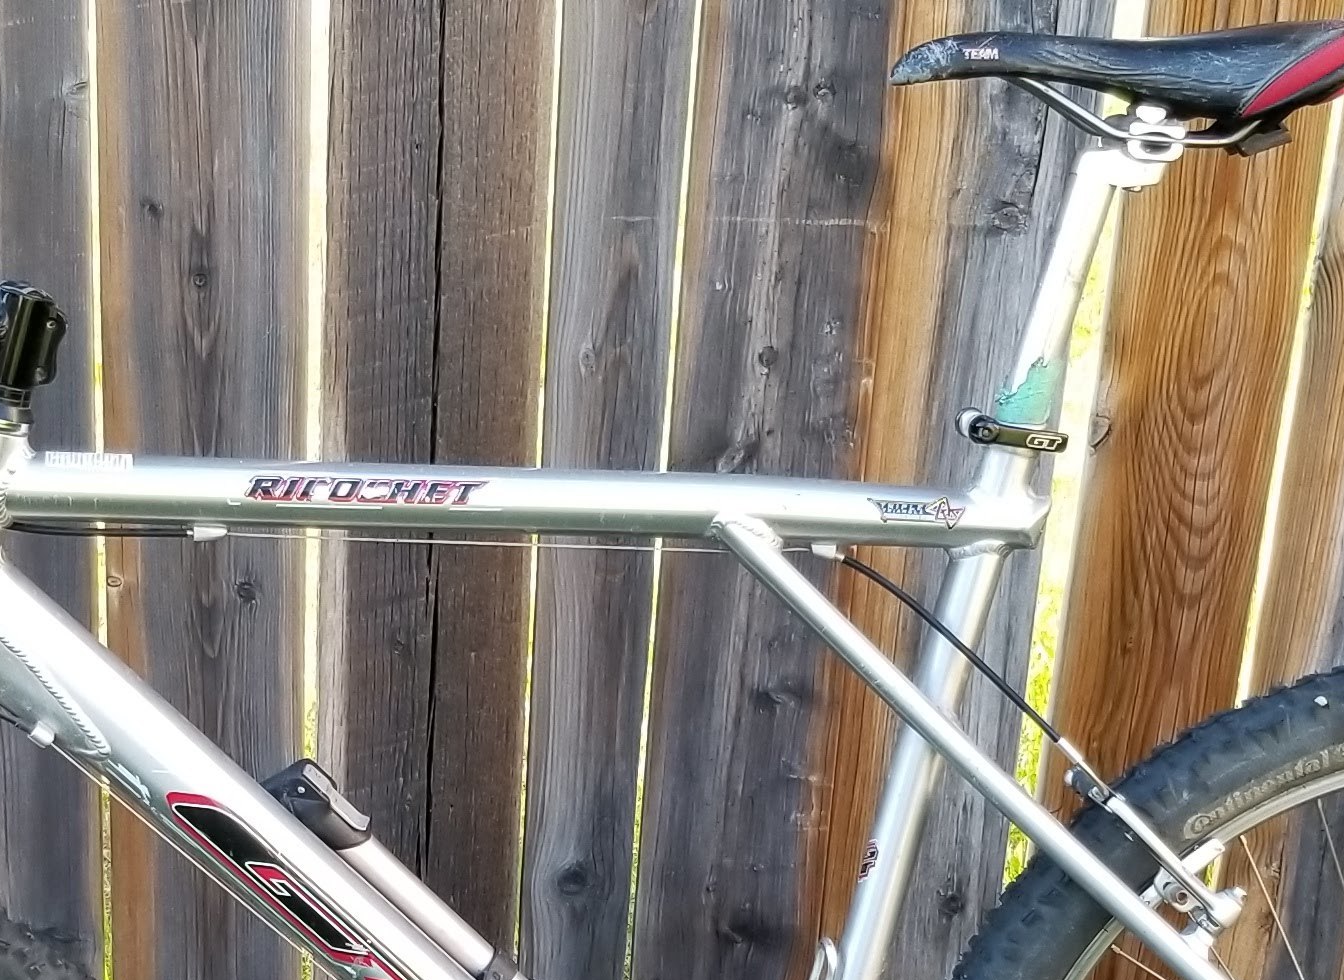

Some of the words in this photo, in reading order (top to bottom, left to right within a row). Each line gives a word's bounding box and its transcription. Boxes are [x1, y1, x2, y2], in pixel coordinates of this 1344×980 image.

[962, 47, 1000, 60] TEAM
[1026, 433, 1062, 451] GT
[243, 474, 490, 506] RICOCHET
